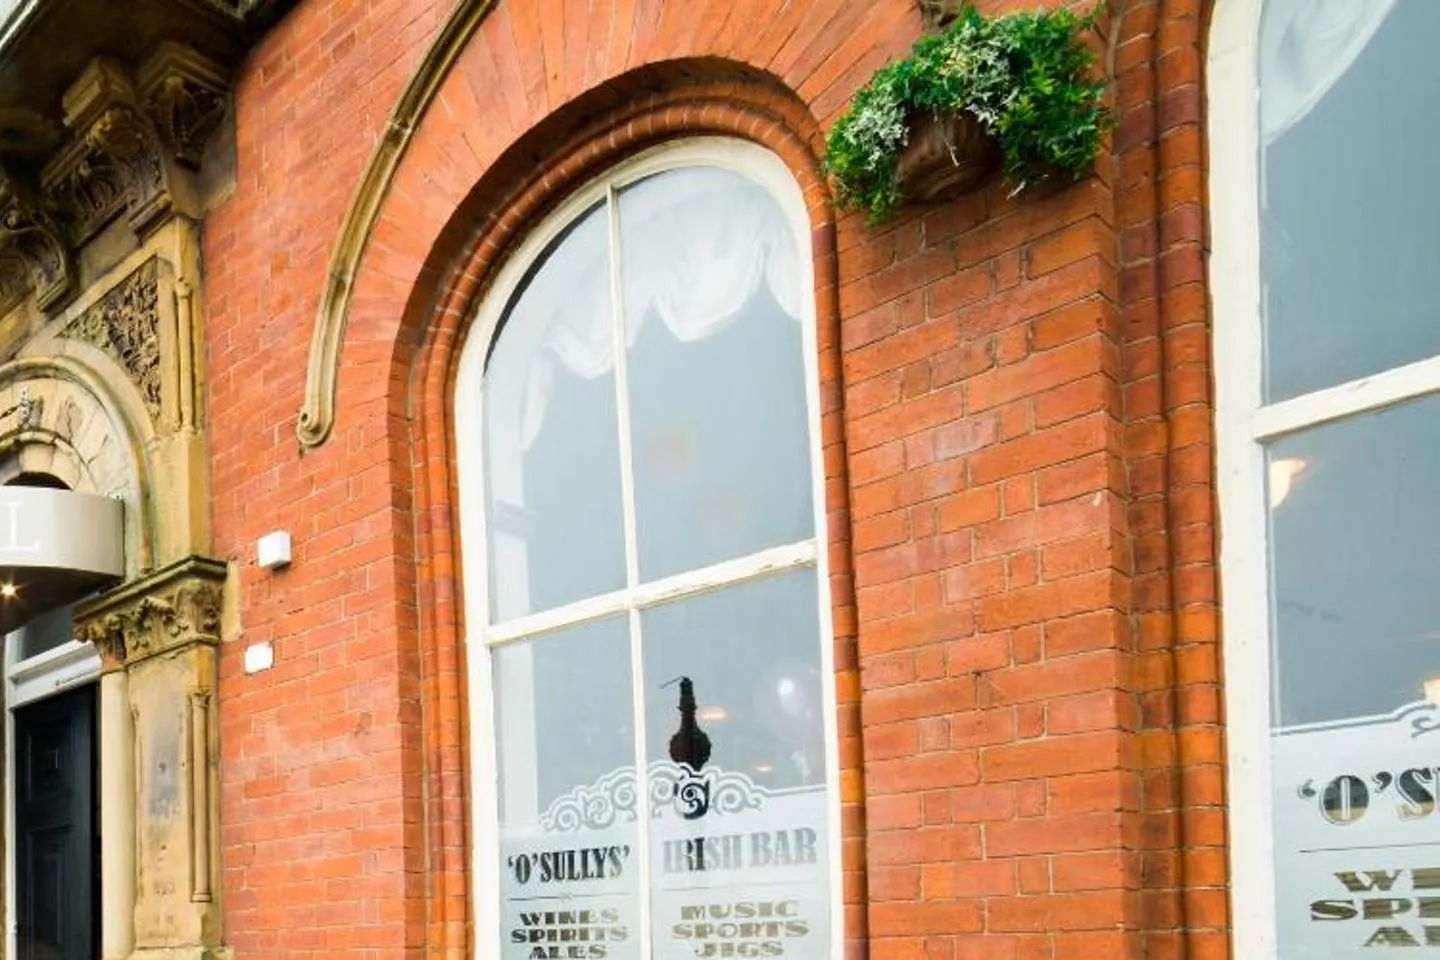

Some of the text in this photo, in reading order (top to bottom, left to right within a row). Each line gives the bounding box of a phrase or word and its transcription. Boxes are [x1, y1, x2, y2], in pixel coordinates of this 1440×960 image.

[1297, 767, 1440, 825] 'O'S
[663, 827, 817, 873] IRISH BAR
[520, 908, 619, 926] WINES
[681, 901, 798, 920] MUSIC
[511, 926, 628, 943] SPIRITS
[672, 920, 810, 939] SPORTS
[529, 944, 607, 960] ALES
[695, 940, 784, 957] JIGS
